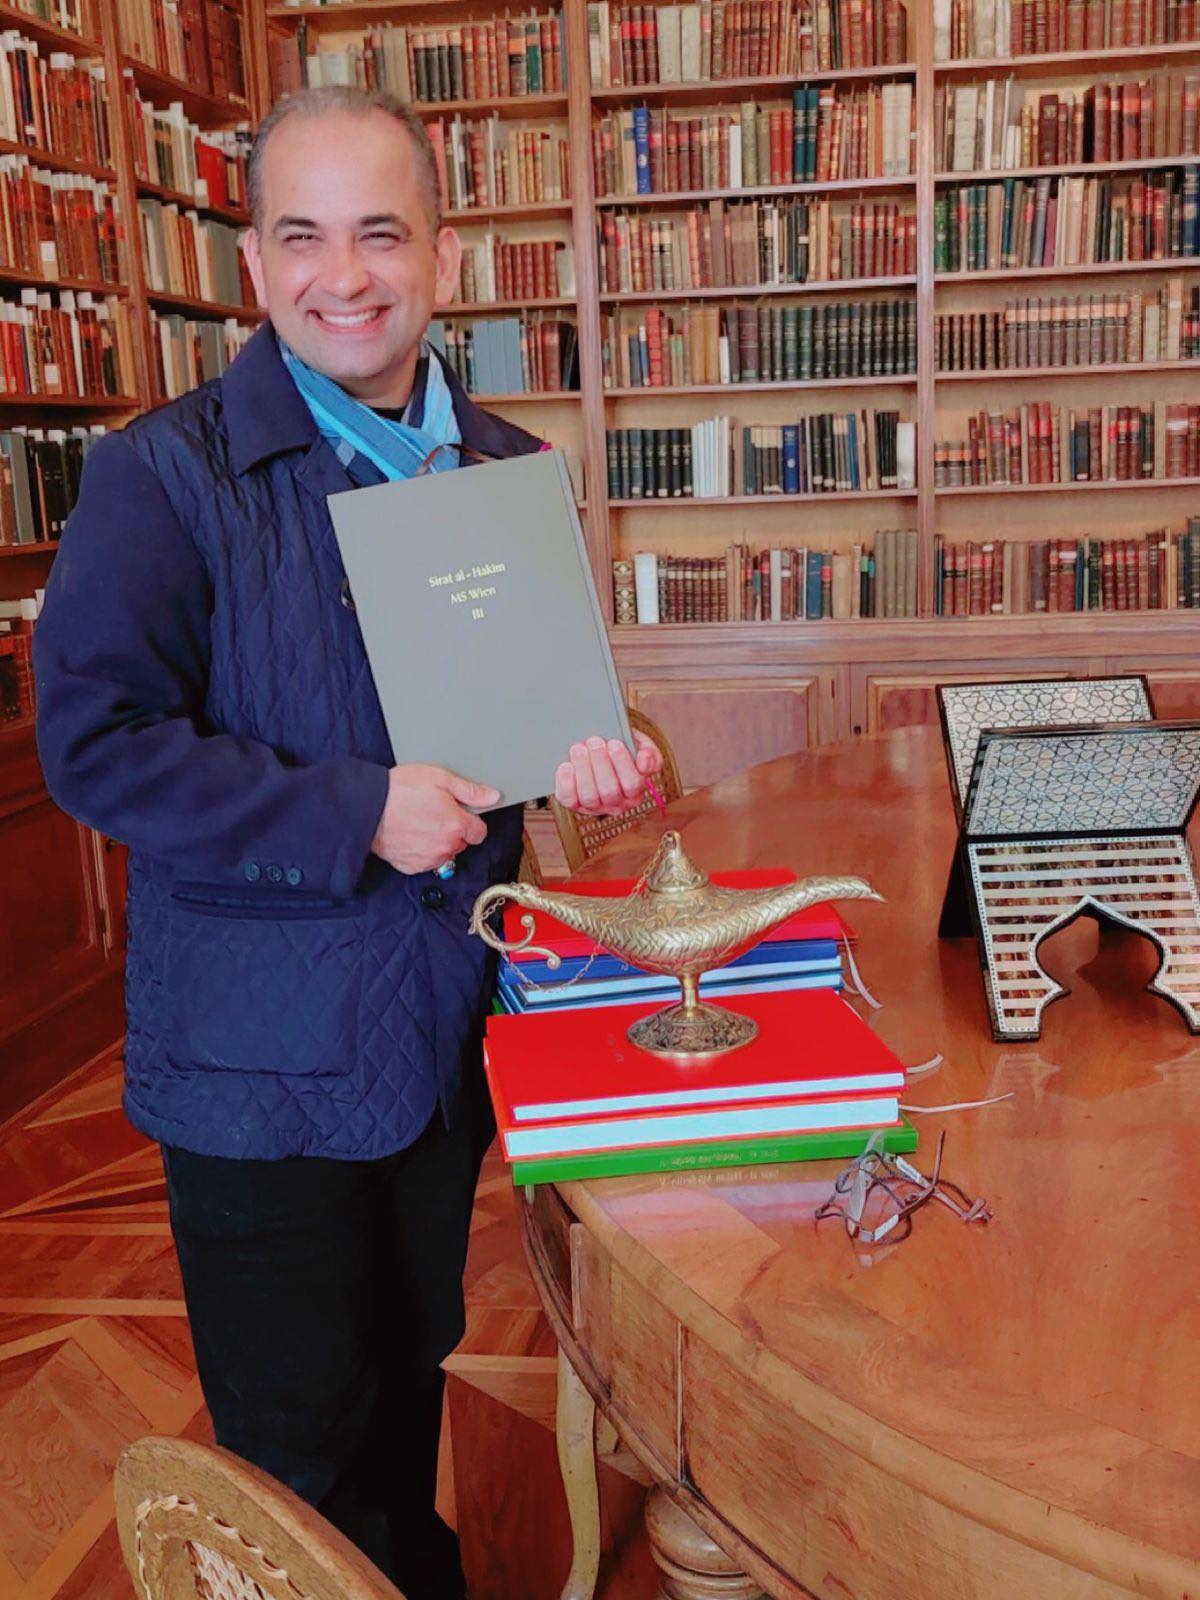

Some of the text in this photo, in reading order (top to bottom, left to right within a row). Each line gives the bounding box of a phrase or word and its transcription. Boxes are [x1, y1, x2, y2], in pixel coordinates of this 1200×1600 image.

[428, 573, 453, 588] Sirat
[450, 586, 497, 604] MS Wien
[471, 607, 485, 620] III
